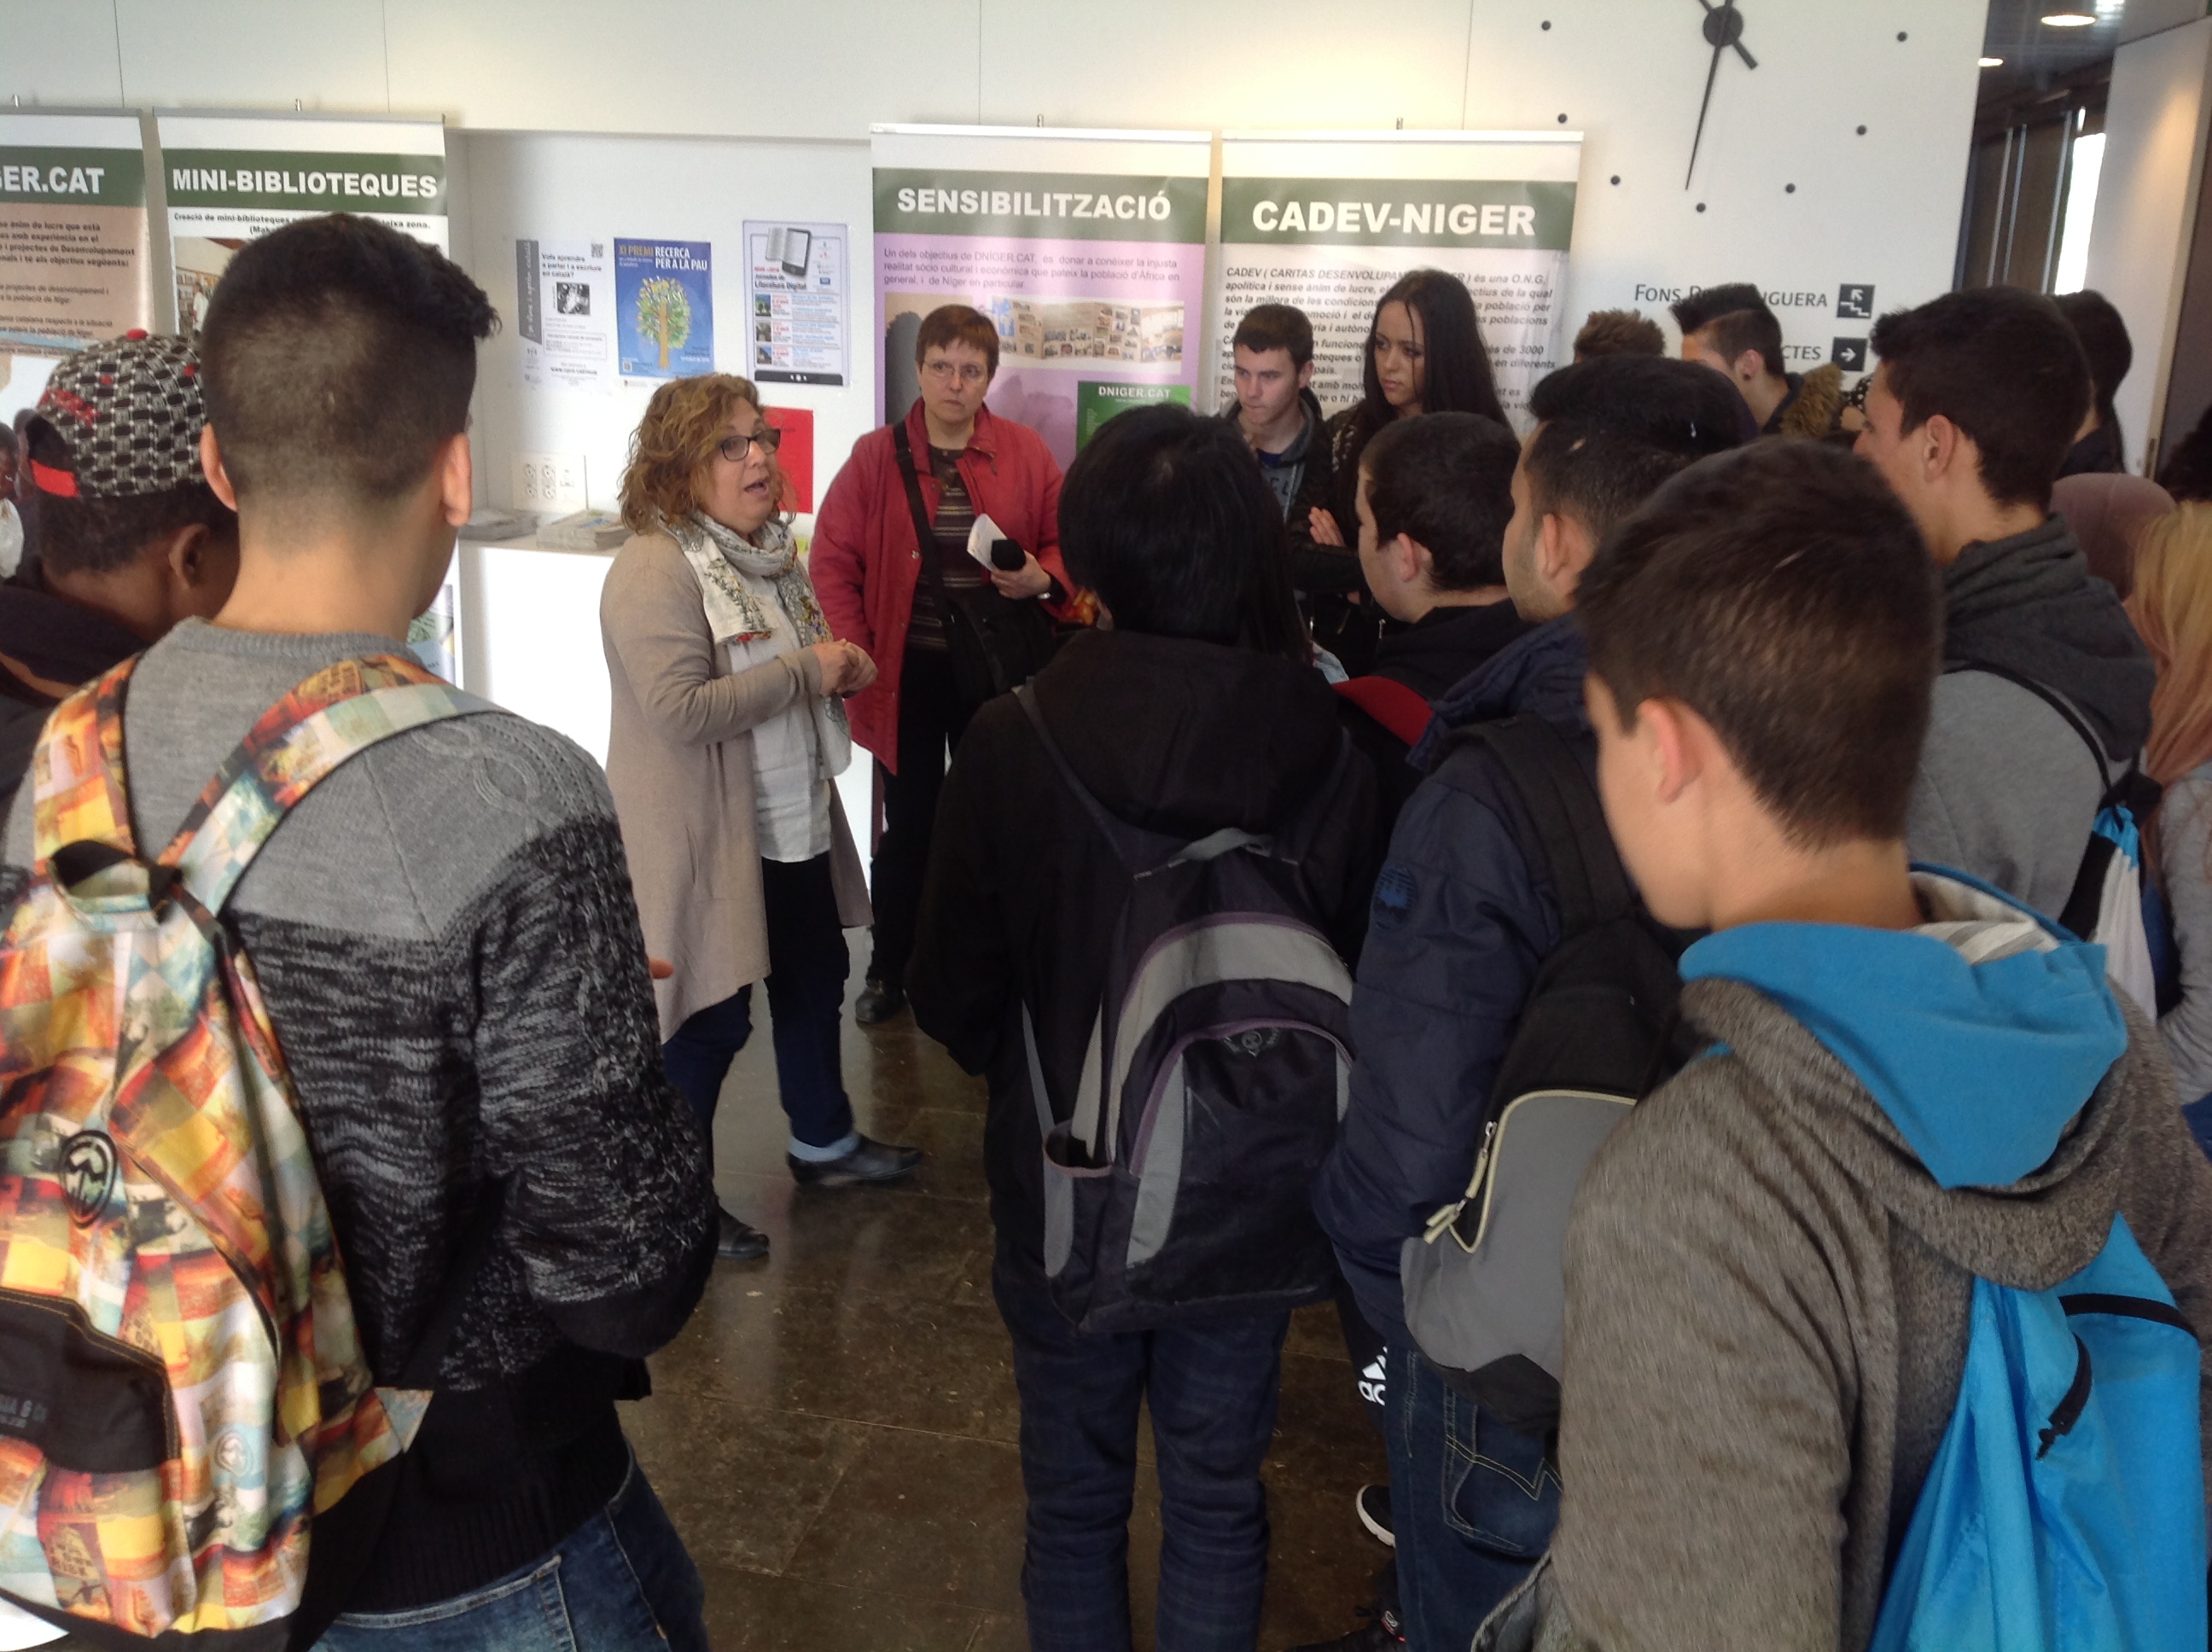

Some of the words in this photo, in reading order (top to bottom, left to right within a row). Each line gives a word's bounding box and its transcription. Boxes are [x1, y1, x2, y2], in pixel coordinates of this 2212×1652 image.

[0, 165, 105, 195] ER.CAT
[172, 168, 438, 198] MINI-BIBLIOTEQUES
[897, 187, 1172, 220] SENSIBILITZACIÓ
[205, 212, 214, 221] de
[1252, 201, 1535, 236] CADEV-NIGER
[32, 220, 43, 230] de
[655, 246, 690, 259] RECERCA
[884, 248, 897, 257] Un
[899, 248, 917, 259] dels
[919, 249, 958, 261] objectius
[960, 251, 972, 261] de
[1059, 255, 1084, 265] donar
[1137, 257, 1144, 266] la
[1147, 257, 1178, 270] injusta
[655, 257, 672, 270] PER
[678, 259, 690, 270] LA
[690, 259, 708, 271] PAU
[884, 262, 913, 271] realitat
[940, 263, 973, 274] cultural
[1031, 269, 1049, 278] que
[1051, 270, 1078, 280] pateix
[1080, 270, 1089, 278] la
[1091, 270, 1128, 281] població
[928, 276, 940, 285] de
[1226, 267, 1262, 277] CADEV
[1270, 268, 1316, 279] CARITAS
[1488, 275, 1509, 283] una
[1274, 283, 1304, 292] sense
[1333, 283, 1347, 293] de
[1472, 288, 1498, 297] ctius
[1500, 288, 1514, 298] de
[1516, 288, 1527, 298] la
[1528, 289, 1553, 300] qual
[1634, 283, 1681, 301] FONS
[1244, 294, 1254, 304] la
[1291, 295, 1306, 305] de
[1307, 295, 1322, 305] les
[1532, 303, 1551, 313] per
[1224, 306, 1232, 317] la
[1305, 308, 1341, 319] omoció
[1352, 310, 1362, 320] el
[1488, 314, 1549, 326] poblacions
[1224, 319, 1236, 329] de
[1503, 344, 1516, 354] de
[1519, 345, 1545, 355] 3000
[1313, 352, 1356, 364] oteques
[1097, 385, 1172, 398] DNIGER.CAT
[1318, 380, 1340, 390] amb
[1331, 394, 1338, 403] o
